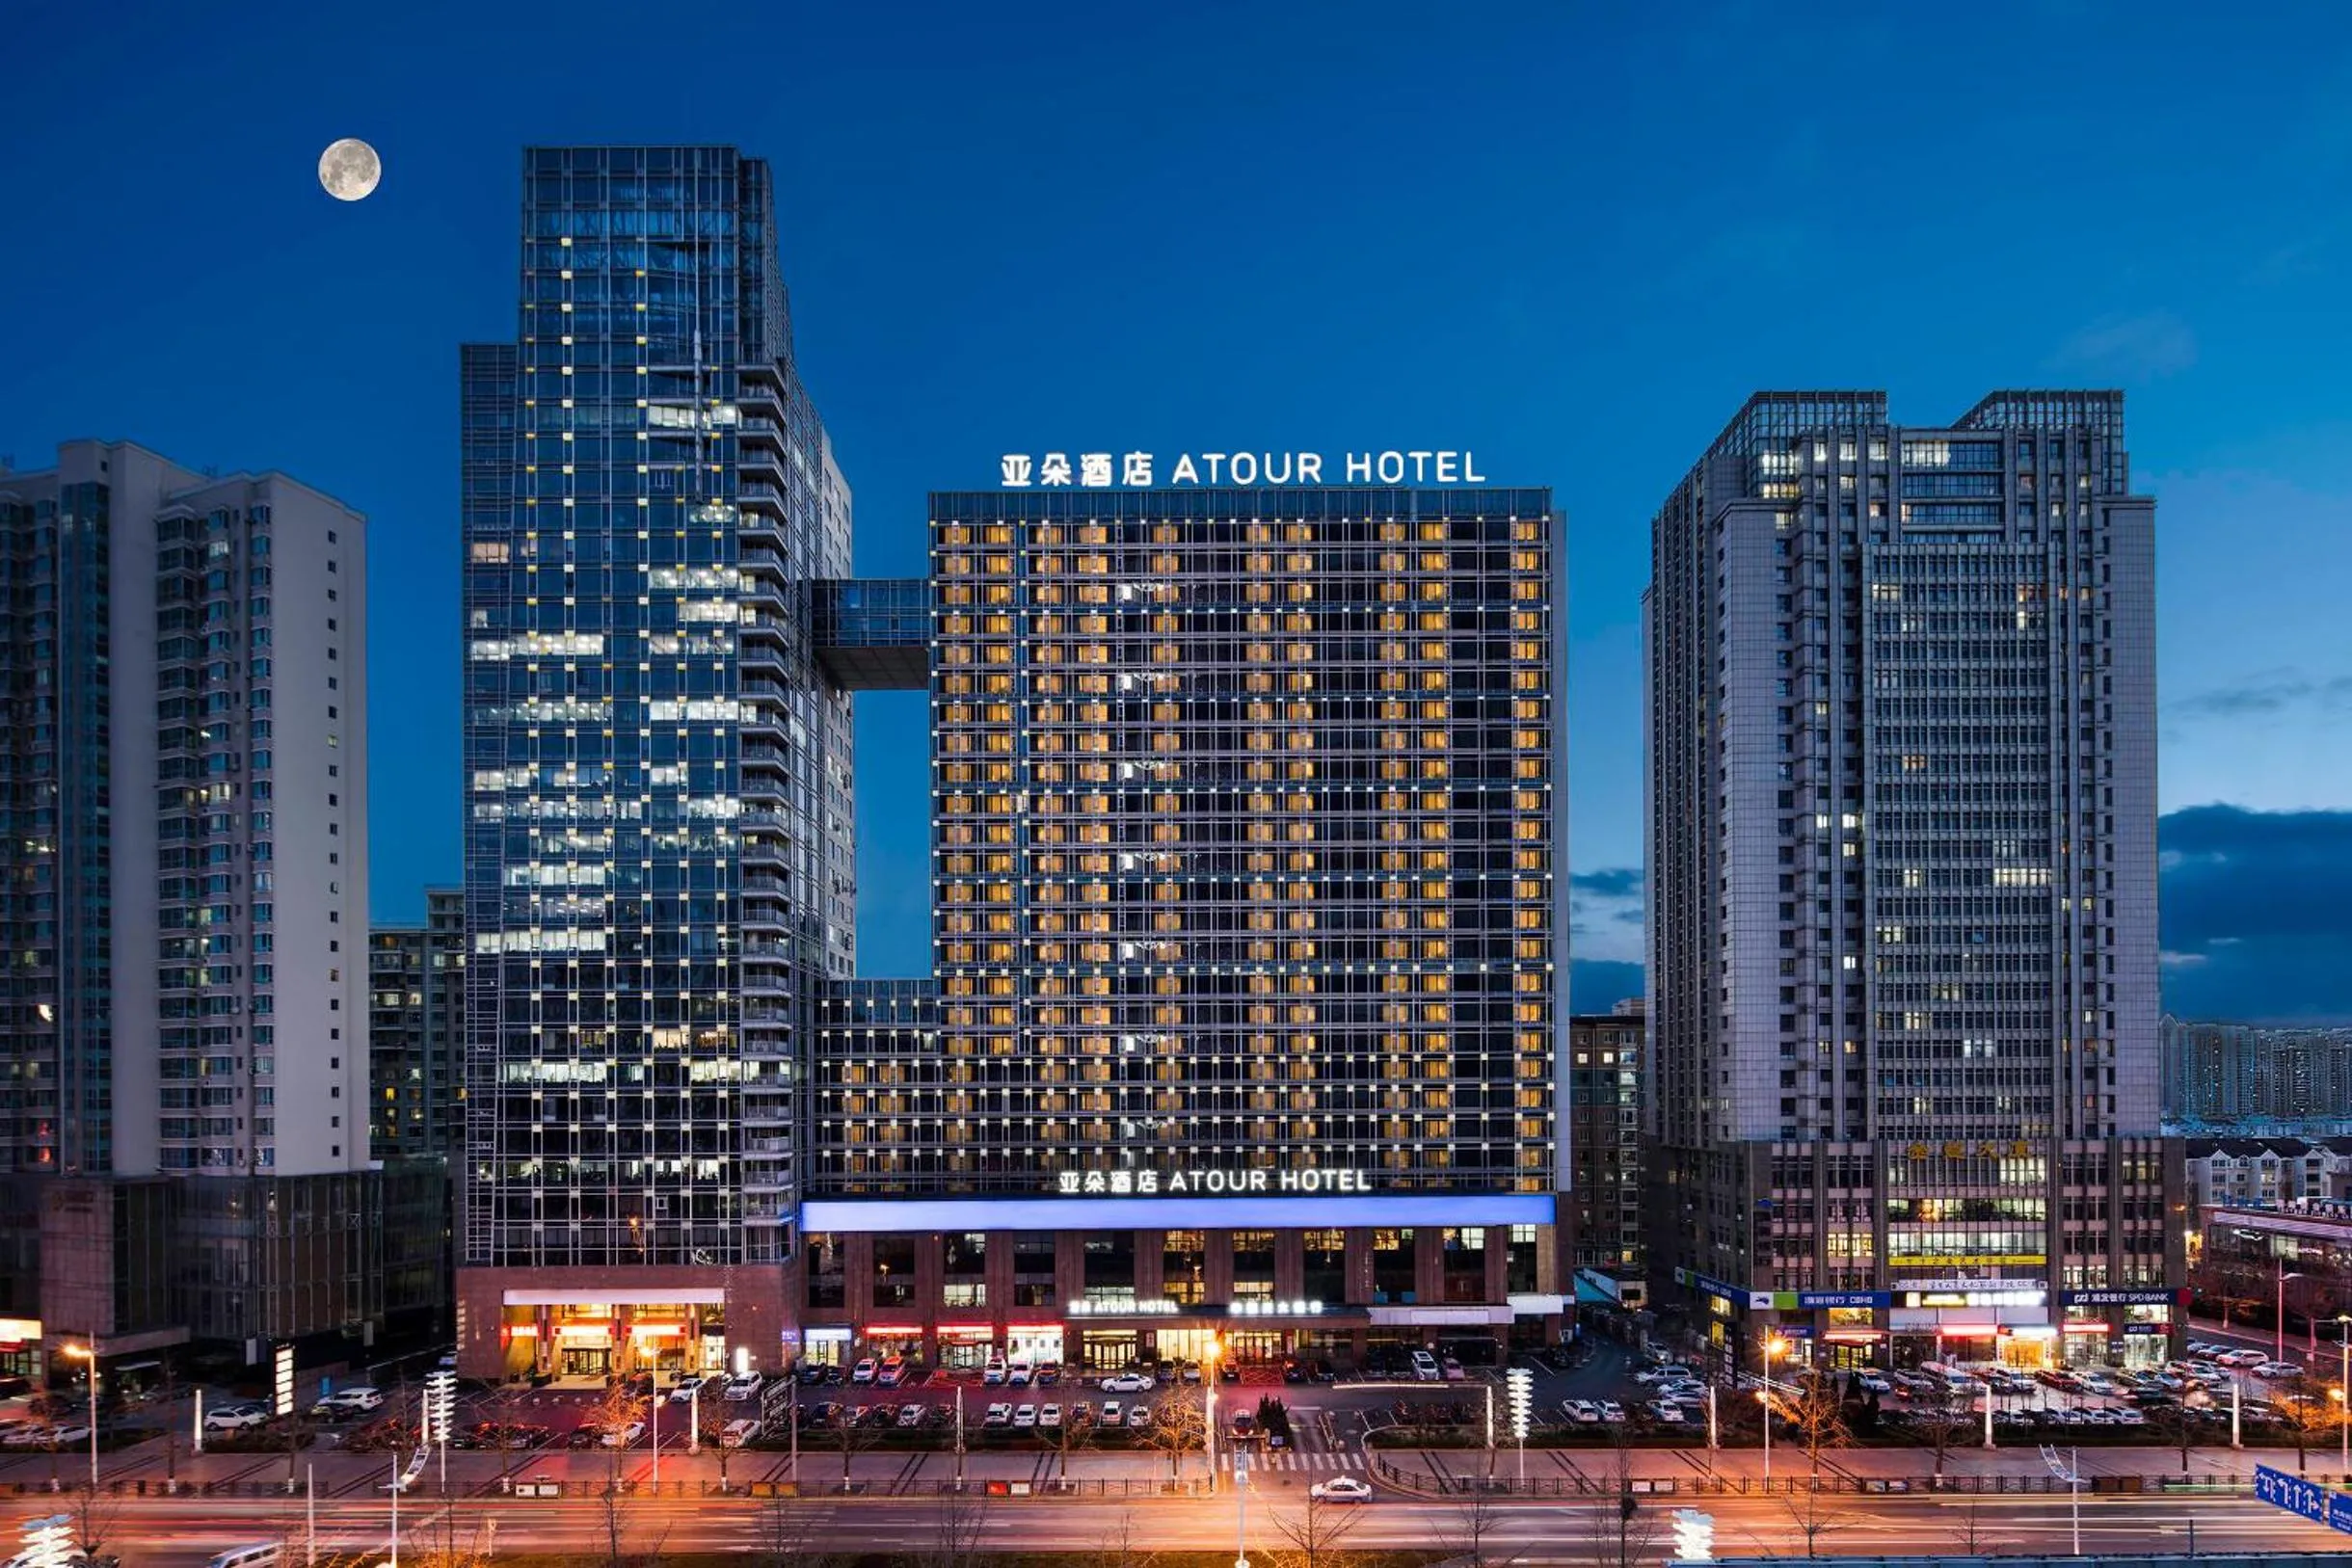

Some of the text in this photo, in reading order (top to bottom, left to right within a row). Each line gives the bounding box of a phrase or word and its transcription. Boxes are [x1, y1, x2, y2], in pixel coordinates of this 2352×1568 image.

[1001, 450, 1485, 488] 亚朵酒店 ATOUR HOTEL
[1058, 1169, 1372, 1193] 亚朵酒店 ATOUR HOTEL
